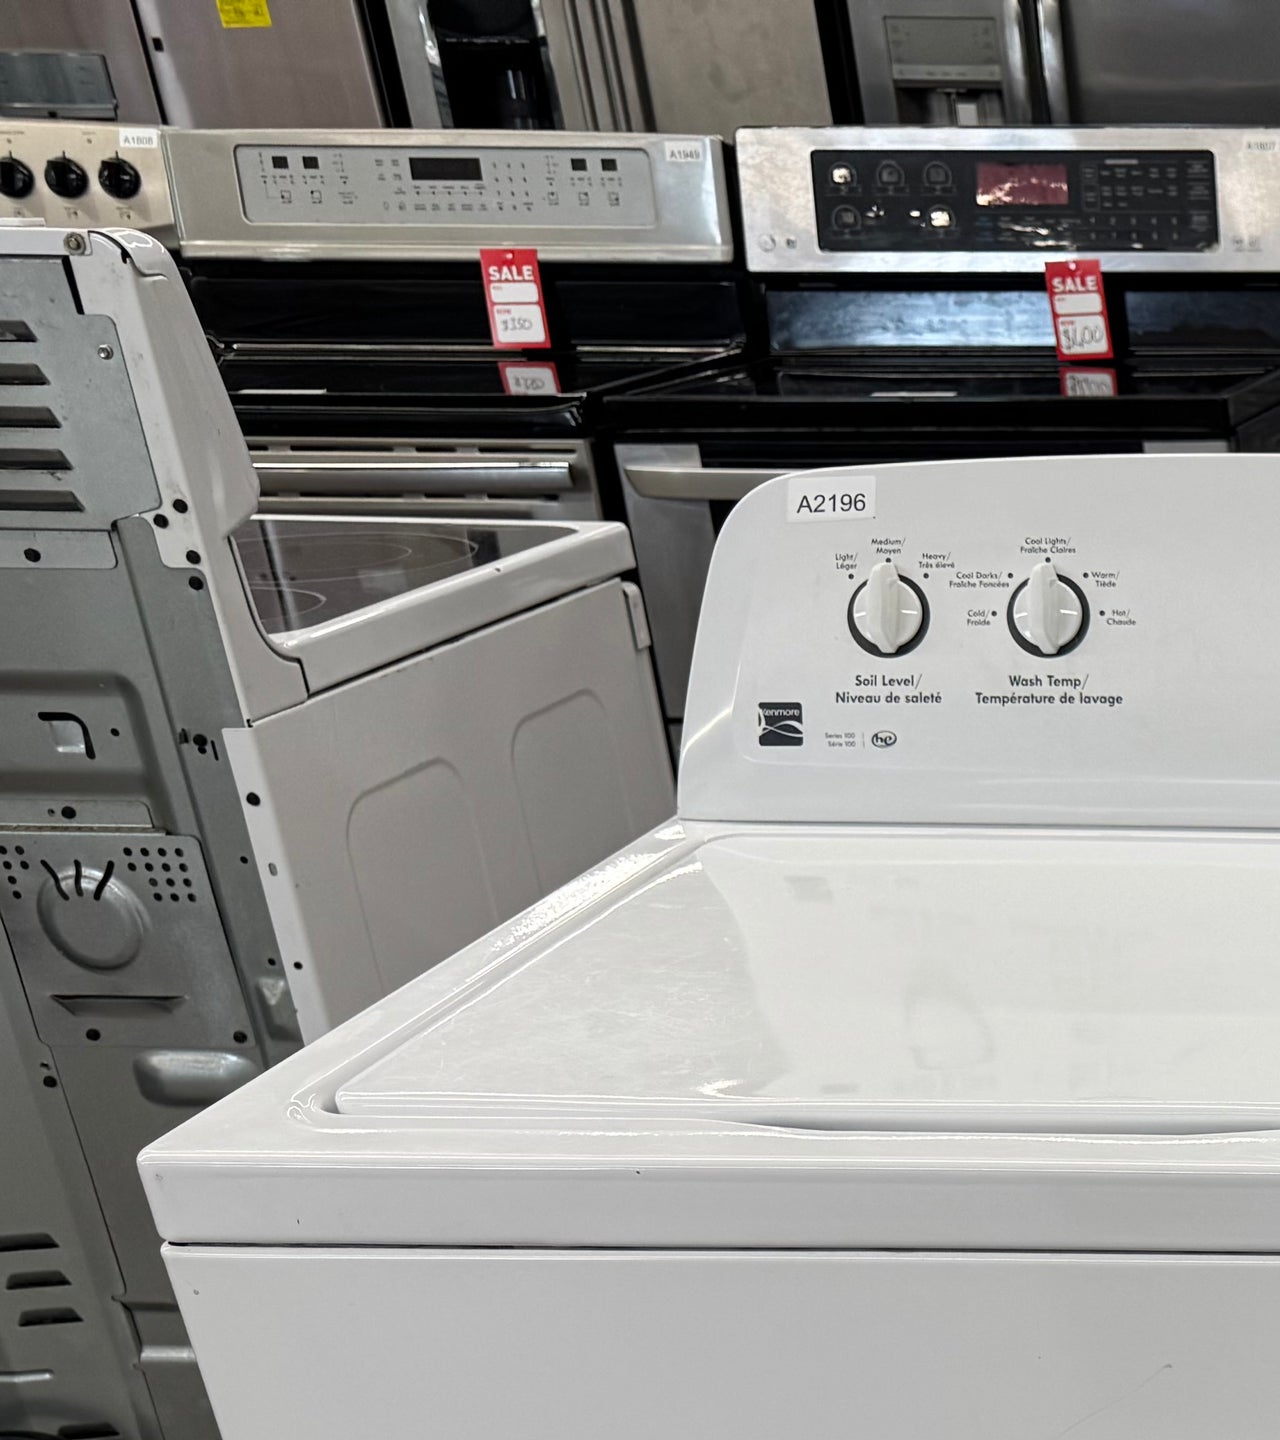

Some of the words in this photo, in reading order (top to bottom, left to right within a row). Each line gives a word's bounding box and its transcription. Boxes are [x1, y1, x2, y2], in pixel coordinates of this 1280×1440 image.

[489, 265, 534, 281] SALE
[1051, 275, 1098, 292] SALE
[796, 493, 867, 514] A2196
[871, 537, 906, 547] Medium/
[1025, 537, 1043, 546] Cool
[1045, 536, 1071, 548] Lights/
[876, 547, 902, 555] Moyen
[835, 552, 858, 562] Light/
[836, 562, 857, 571] Léger
[956, 571, 974, 580] Cool
[967, 609, 990, 619] Cold/
[967, 618, 991, 627] Froide
[1106, 618, 1137, 626] Chaude
[855, 674, 878, 688] Soil
[882, 674, 923, 690] Level/
[1009, 675, 1042, 688] Wash
[1048, 674, 1089, 692] Temp/
[835, 692, 881, 705] Niveau
[886, 692, 901, 705] de
[904, 692, 942, 705] saleté
[976, 692, 1055, 707] Température
[1059, 692, 1075, 705] de
[1079, 692, 1123, 707] lavage
[761, 707, 800, 717] Kenmore
